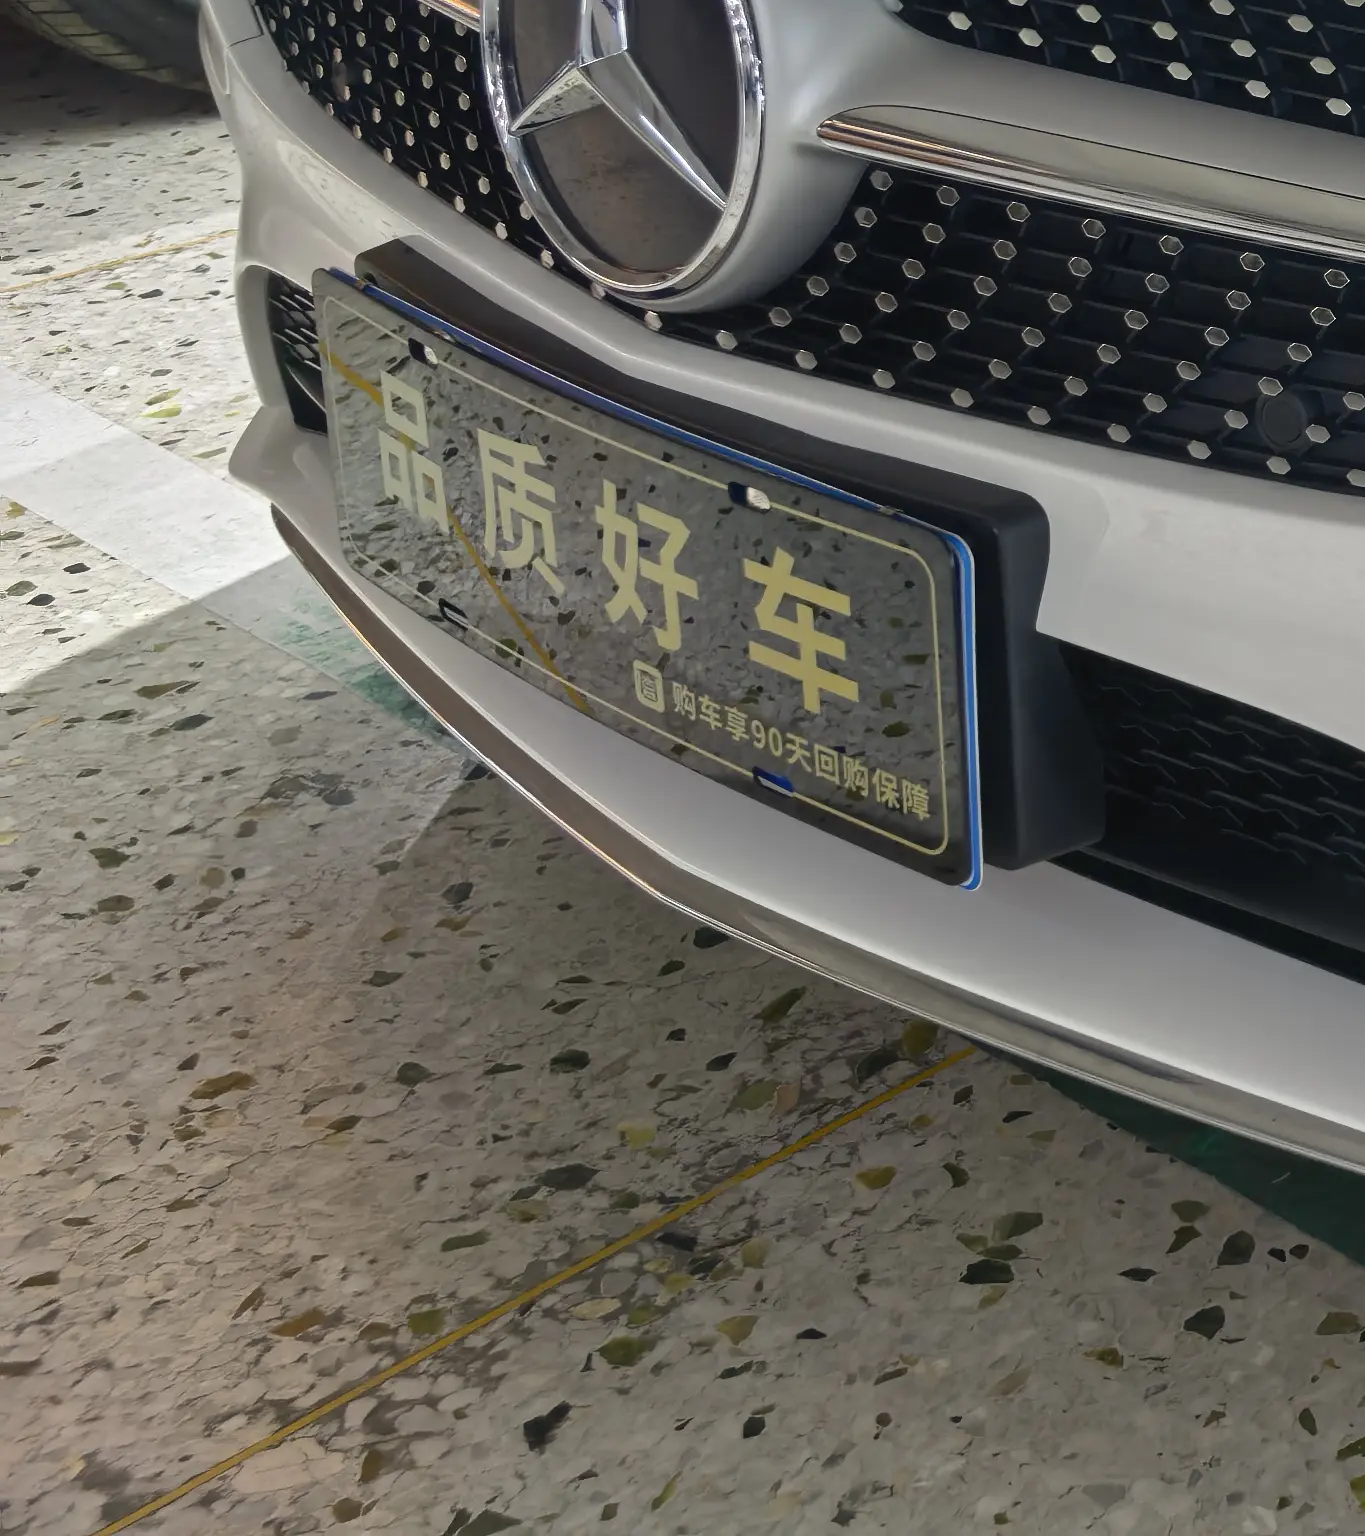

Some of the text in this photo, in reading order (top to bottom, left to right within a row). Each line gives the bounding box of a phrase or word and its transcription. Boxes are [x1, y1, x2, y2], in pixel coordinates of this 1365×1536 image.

[378, 369, 860, 714] 品质好车
[672, 681, 930, 820] 购车享90天回购保障
